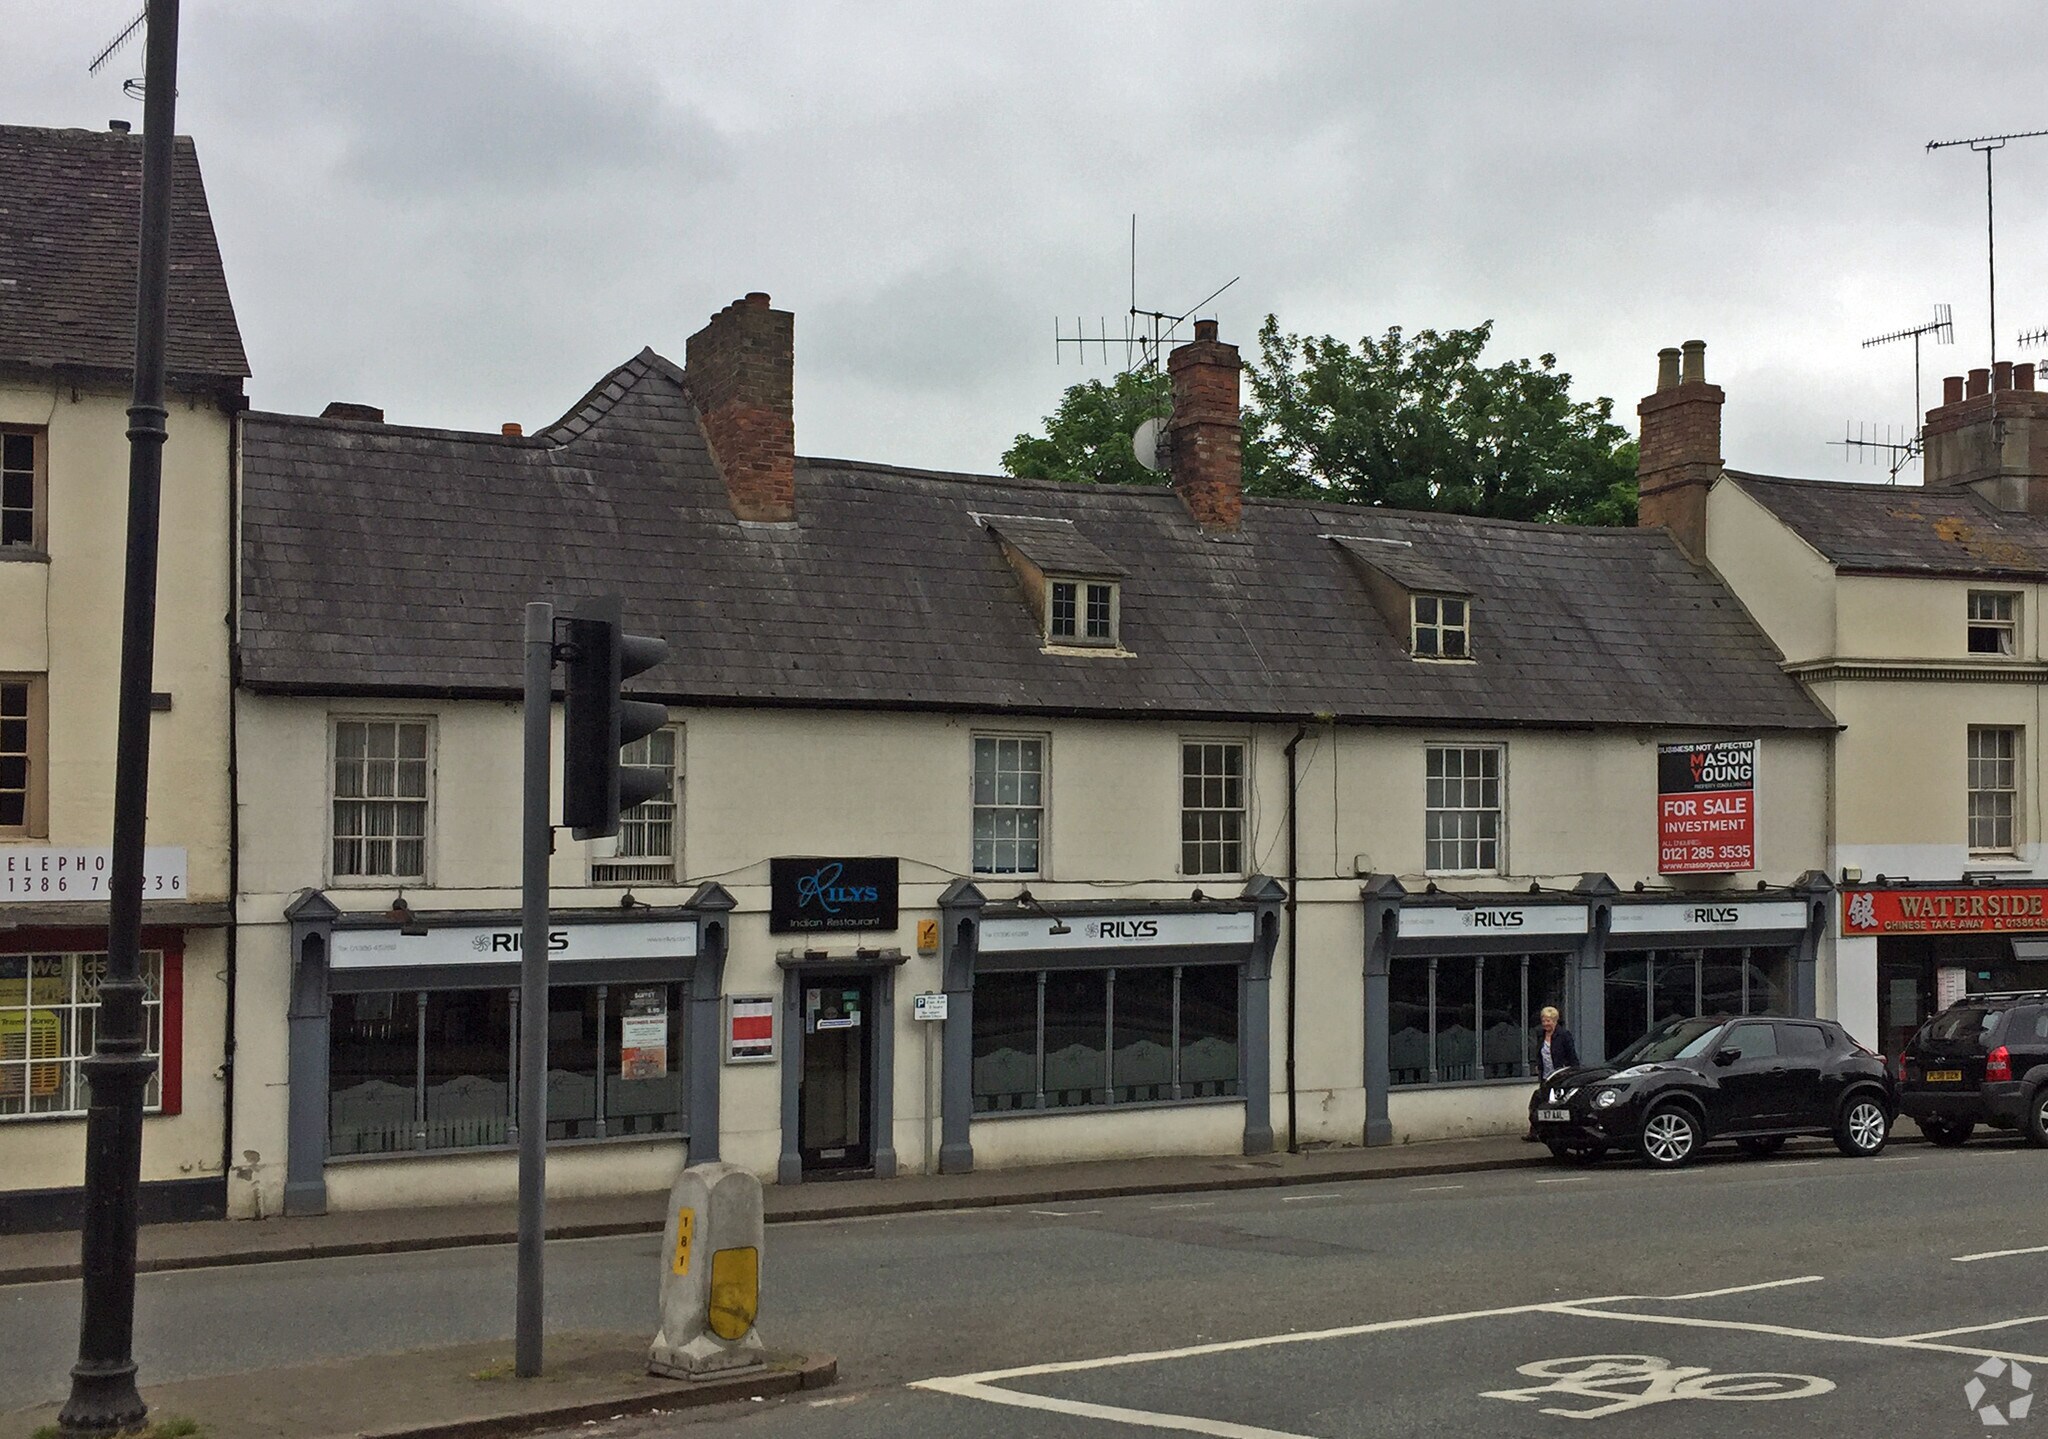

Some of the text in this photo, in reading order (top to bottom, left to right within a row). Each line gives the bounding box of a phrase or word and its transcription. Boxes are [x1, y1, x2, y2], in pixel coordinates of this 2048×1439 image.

[1714, 741, 1753, 751] AFFECTED
[1690, 751, 1752, 767] MASON
[1690, 765, 1752, 782] YOUNG
[1664, 797, 1747, 817] FOR SALE
[1664, 819, 1746, 833] INVESTMENT
[1662, 845, 1751, 861] 0121 285 3535
[7, 856, 105, 872] ELEPHO
[1662, 859, 1751, 870] www.masonyoung.co.uk
[8, 876, 180, 892] 1386 76236
[1848, 893, 1878, 929] 銀
[1900, 895, 2043, 917] WATERSIDE
[790, 917, 880, 928] Indian Restaurant
[1474, 911, 1524, 927] RILYS
[1695, 908, 1739, 923] RILYS
[1100, 920, 1158, 939] RILYS
[1884, 920, 1927, 930] CHINESE
[1931, 919, 1956, 929] TAKE
[1959, 918, 1985, 928] AWAY
[492, 931, 569, 952] RIS
